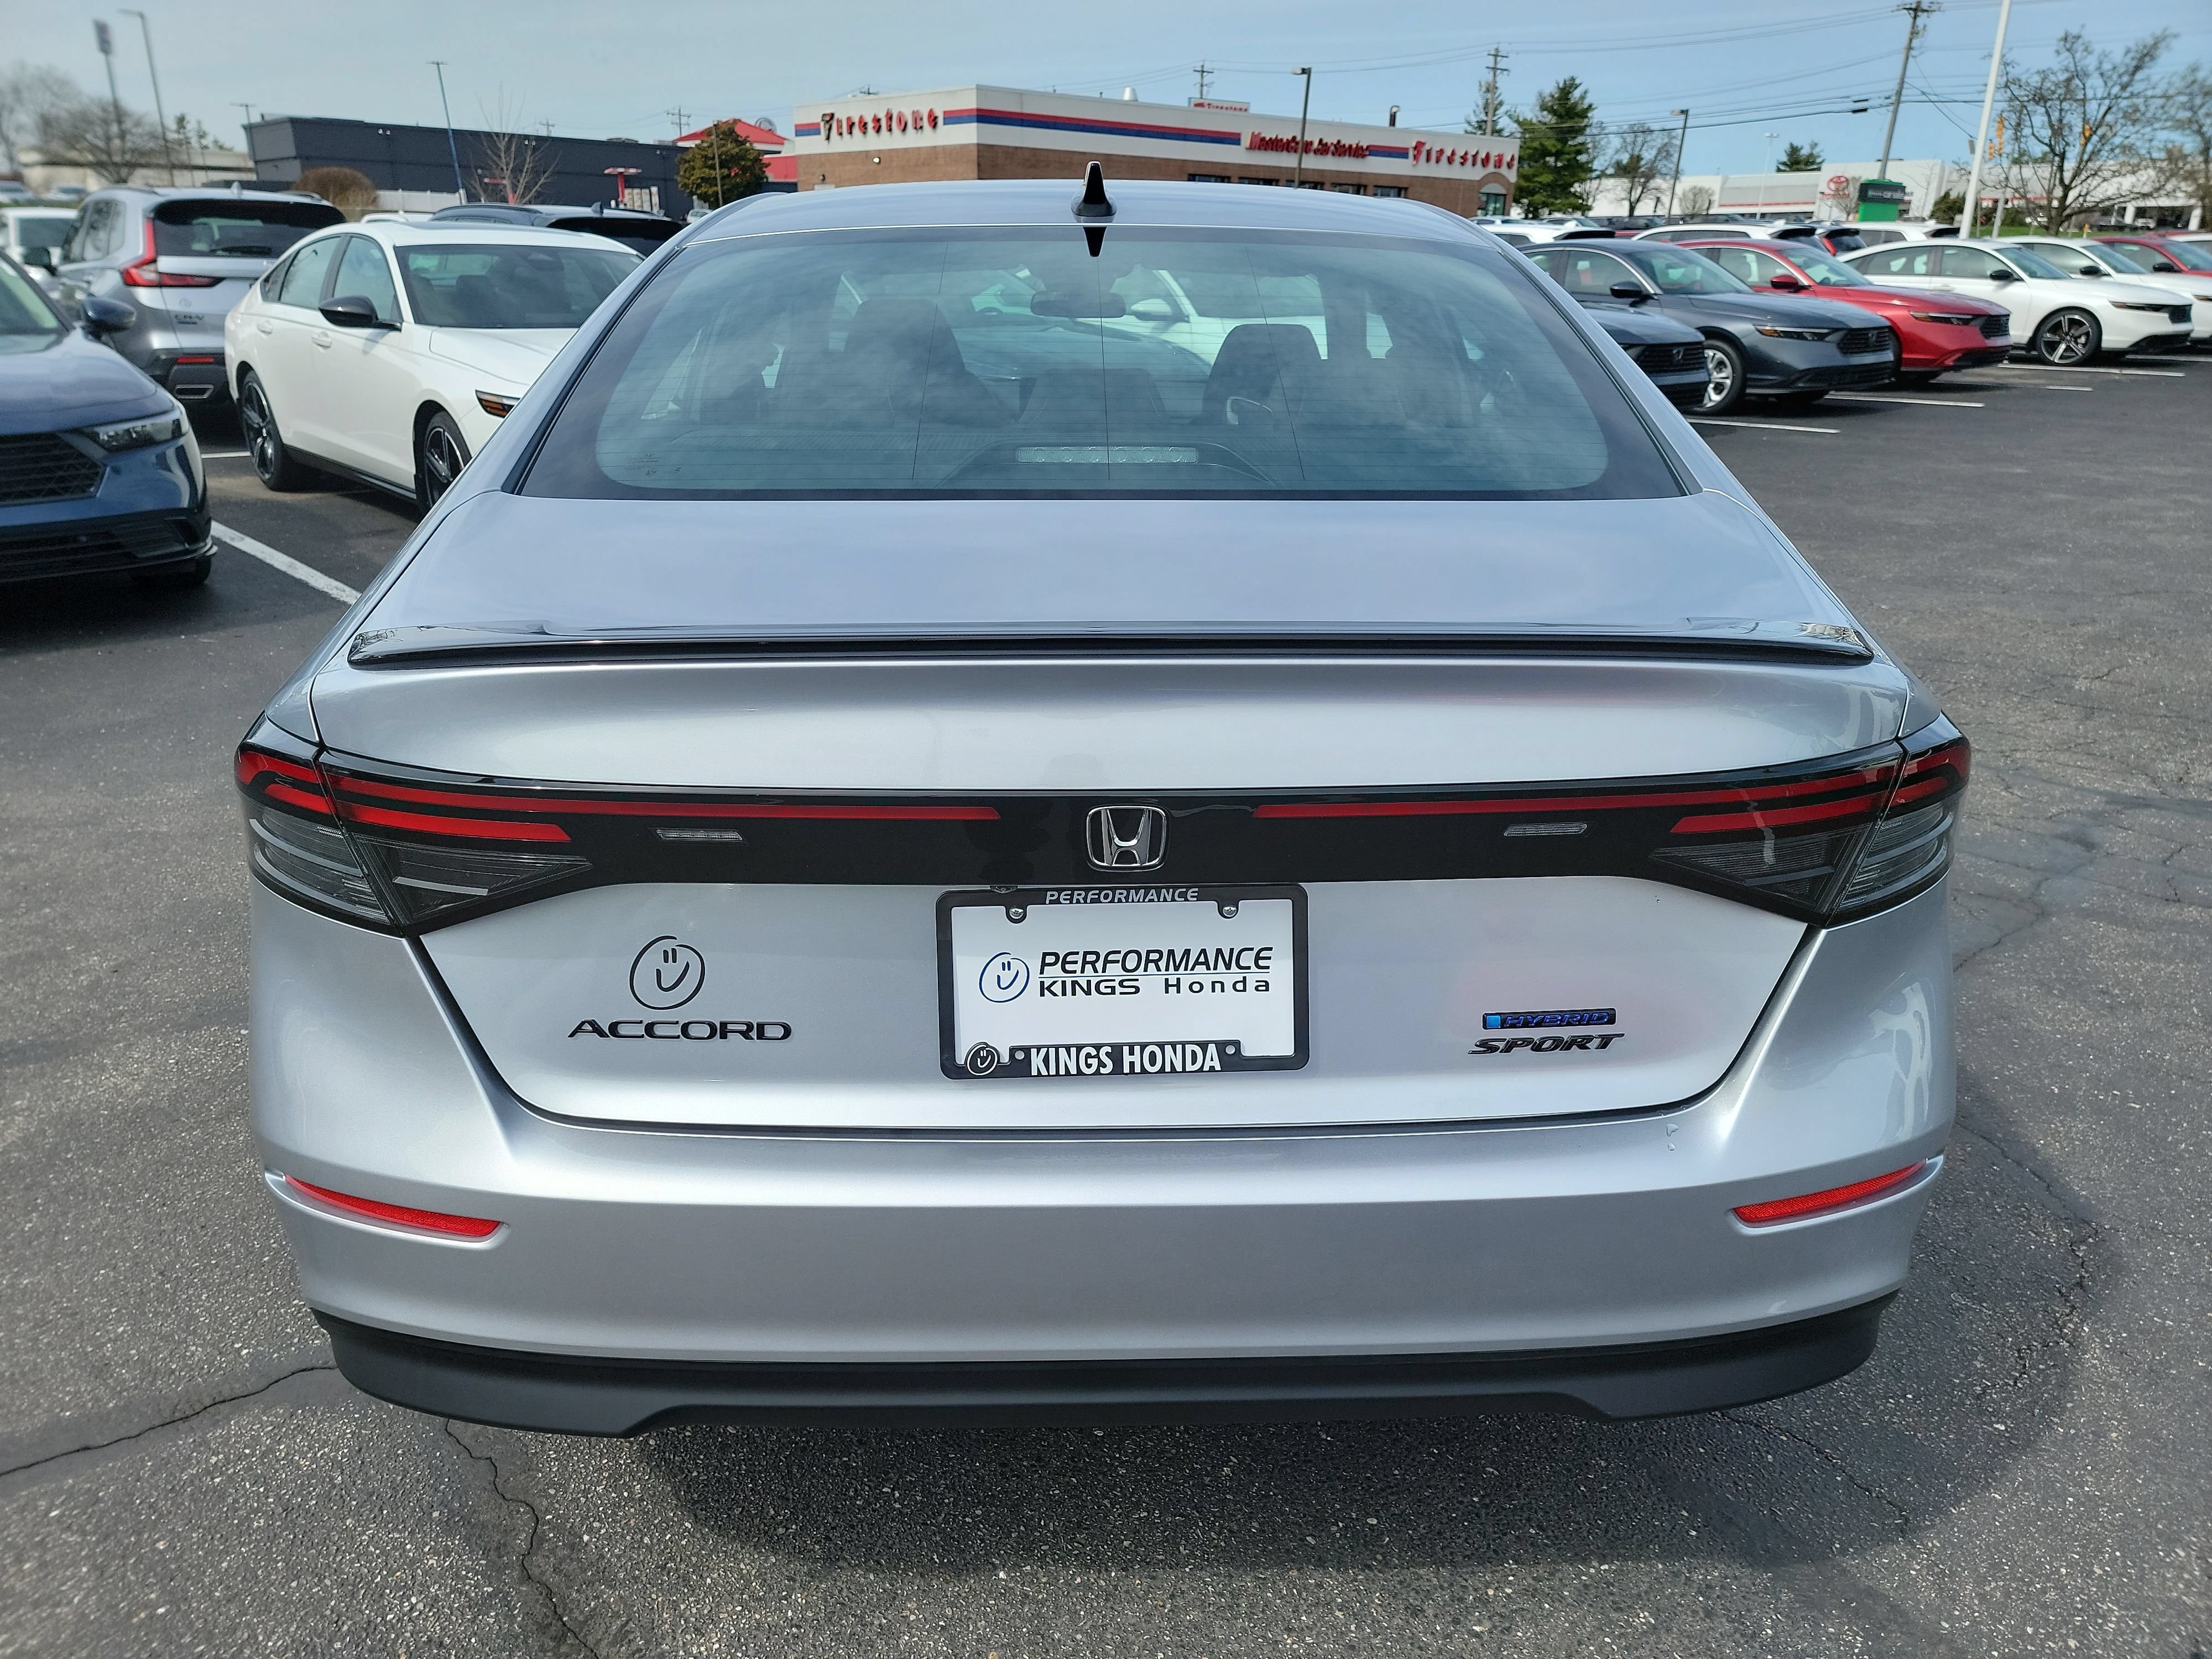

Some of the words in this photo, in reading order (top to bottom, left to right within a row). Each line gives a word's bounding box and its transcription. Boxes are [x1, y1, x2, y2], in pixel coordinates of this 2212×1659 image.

[822, 108, 938, 140] Firestone
[1412, 141, 1515, 169] Firestone
[1046, 888, 1199, 904] PERFORMANCE
[1040, 947, 1273, 974] PERFORMANCE
[1040, 978, 1140, 997] KINGS
[1165, 976, 1270, 994] Honda
[567, 1018, 792, 1041] ACCORD
[1504, 1011, 1610, 1027] HYBRID
[1468, 1033, 1625, 1055] SPORT
[1031, 1046, 1113, 1076] KINGS
[1123, 1044, 1221, 1073] HONDA
